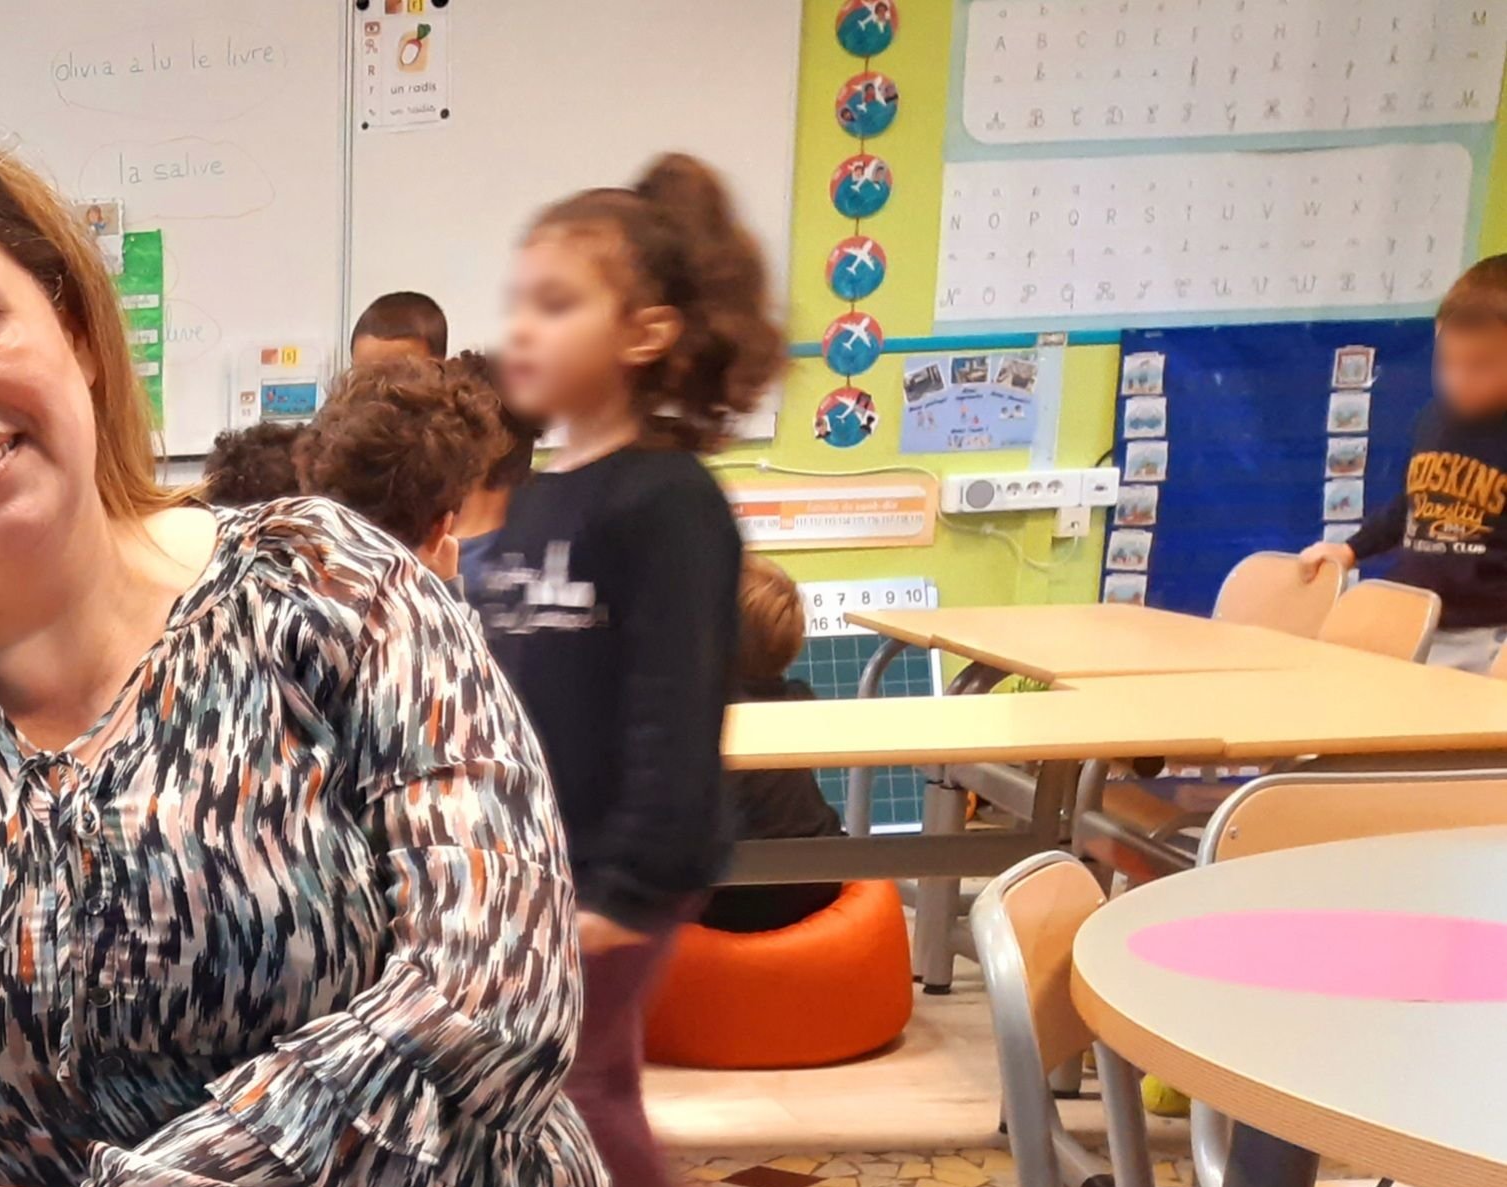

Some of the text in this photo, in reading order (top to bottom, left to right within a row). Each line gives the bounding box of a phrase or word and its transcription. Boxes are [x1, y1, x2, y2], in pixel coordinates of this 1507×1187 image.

[995, 35, 1006, 51] A
[1037, 32, 1047, 49] B
[1077, 30, 1087, 48] C
[1116, 29, 1126, 47] D
[1274, 24, 1286, 40] H
[1472, 10, 1486, 26] M
[55, 52, 115, 81] olivia
[151, 41, 171, 71] lu
[192, 39, 211, 69] le
[227, 36, 275, 66] livre
[368, 65, 376, 76] R
[390, 85, 405, 95] un
[408, 82, 437, 93] radis
[119, 151, 225, 184] la salive
[950, 214, 961, 230] N
[988, 212, 1000, 230] O
[1029, 211, 1040, 227] P
[1068, 208, 1080, 226] Q
[1106, 207, 1117, 225] R
[1144, 206, 1155, 223] S
[1222, 203, 1235, 221] U
[1262, 202, 1275, 220] V
[1303, 200, 1322, 217] W
[982, 286, 996, 304] O
[814, 588, 922, 607] 6 7 8 9 10
[813, 616, 829, 630] 16
